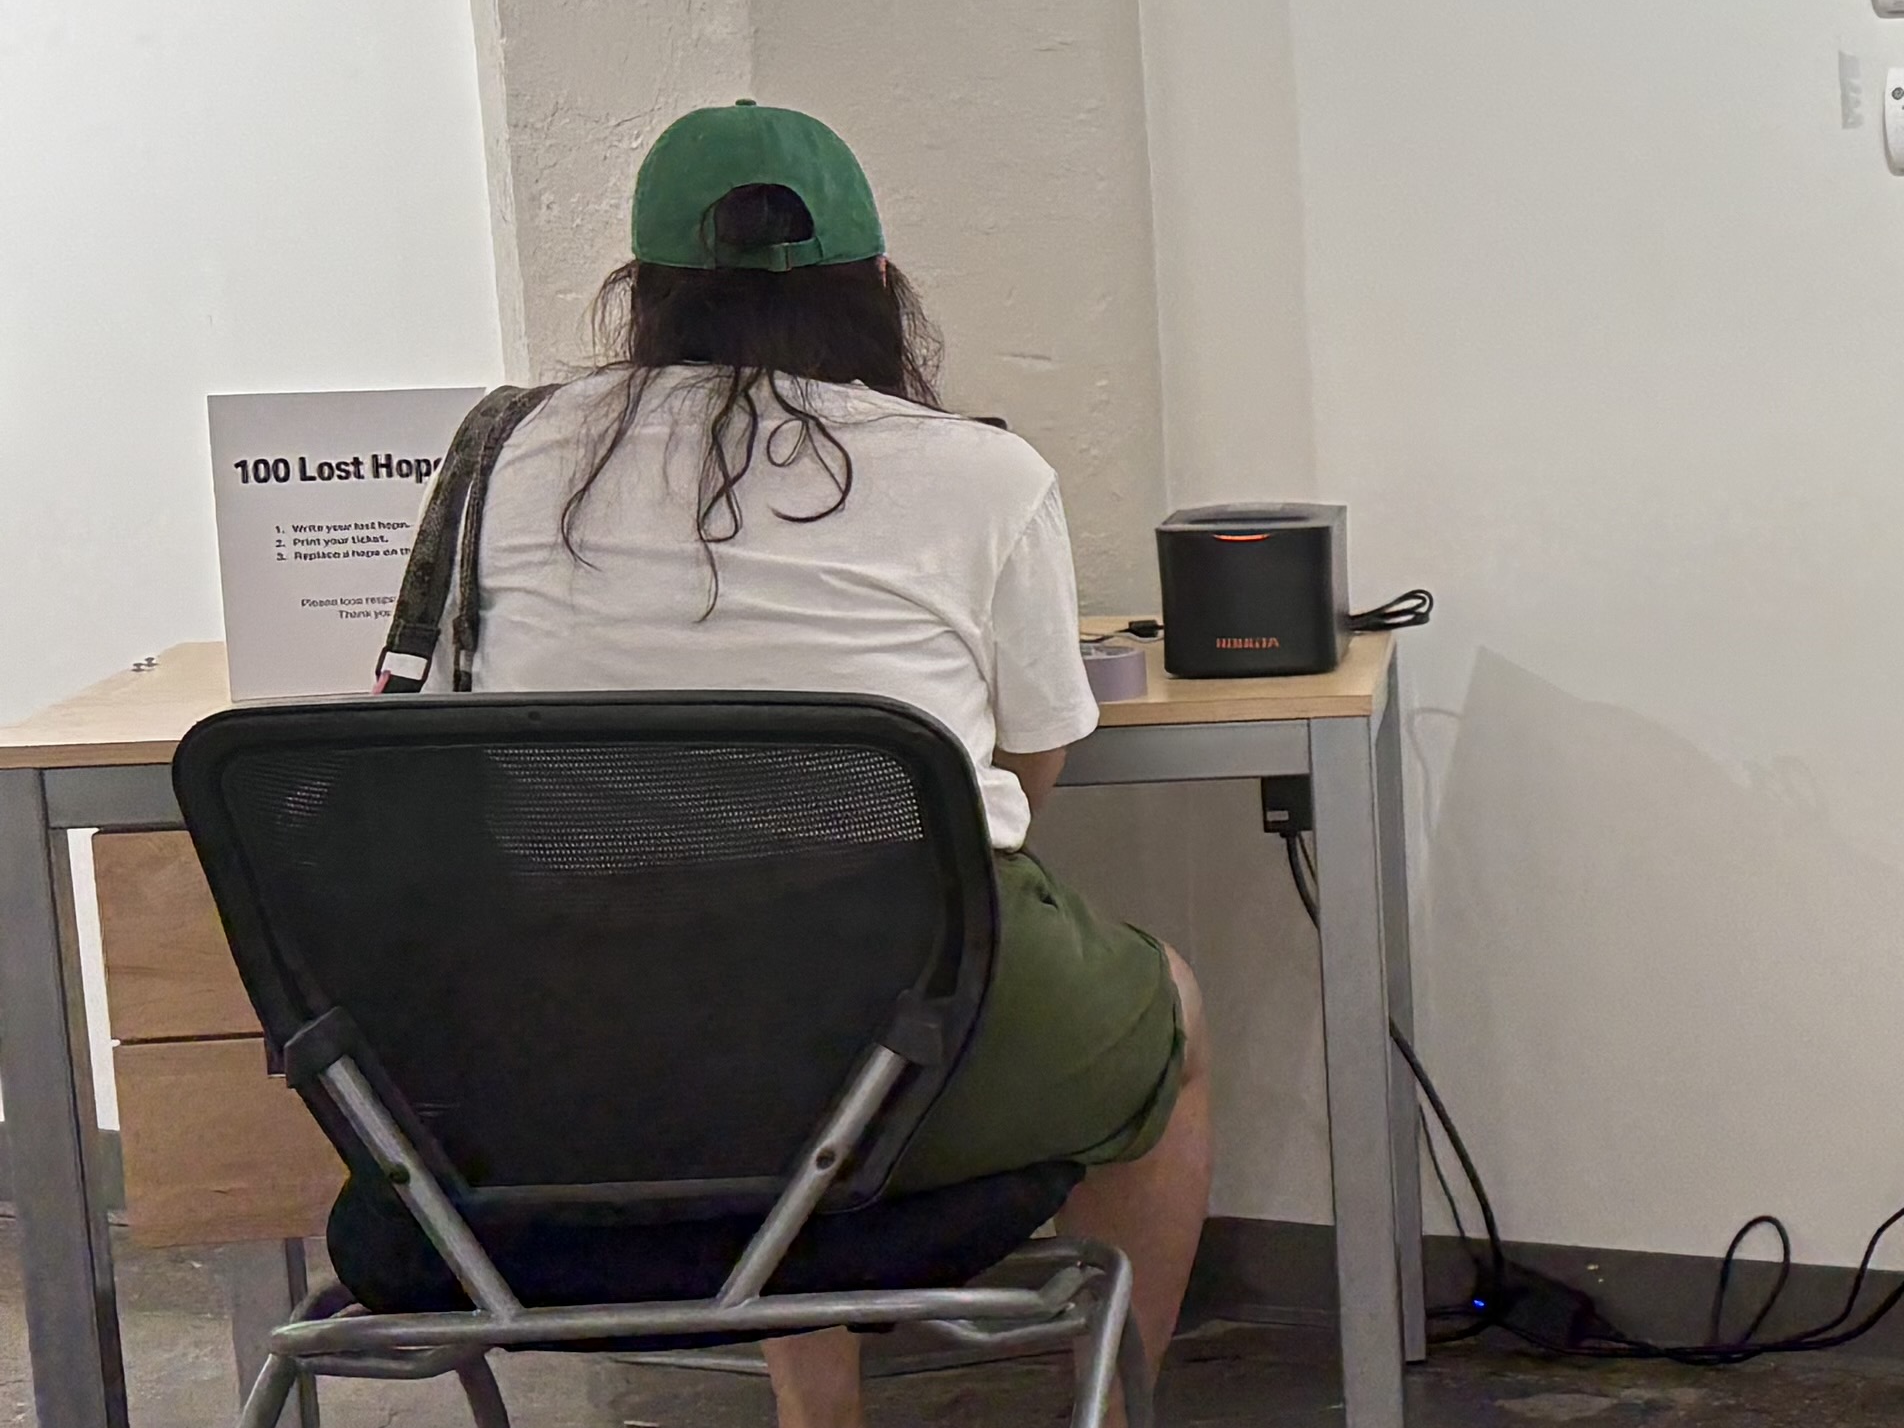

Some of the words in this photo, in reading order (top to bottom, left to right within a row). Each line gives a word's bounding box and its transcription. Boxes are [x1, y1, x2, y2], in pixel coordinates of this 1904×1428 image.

[234, 458, 290, 484] 100
[299, 456, 365, 481] Lost
[372, 454, 442, 484] Hop
